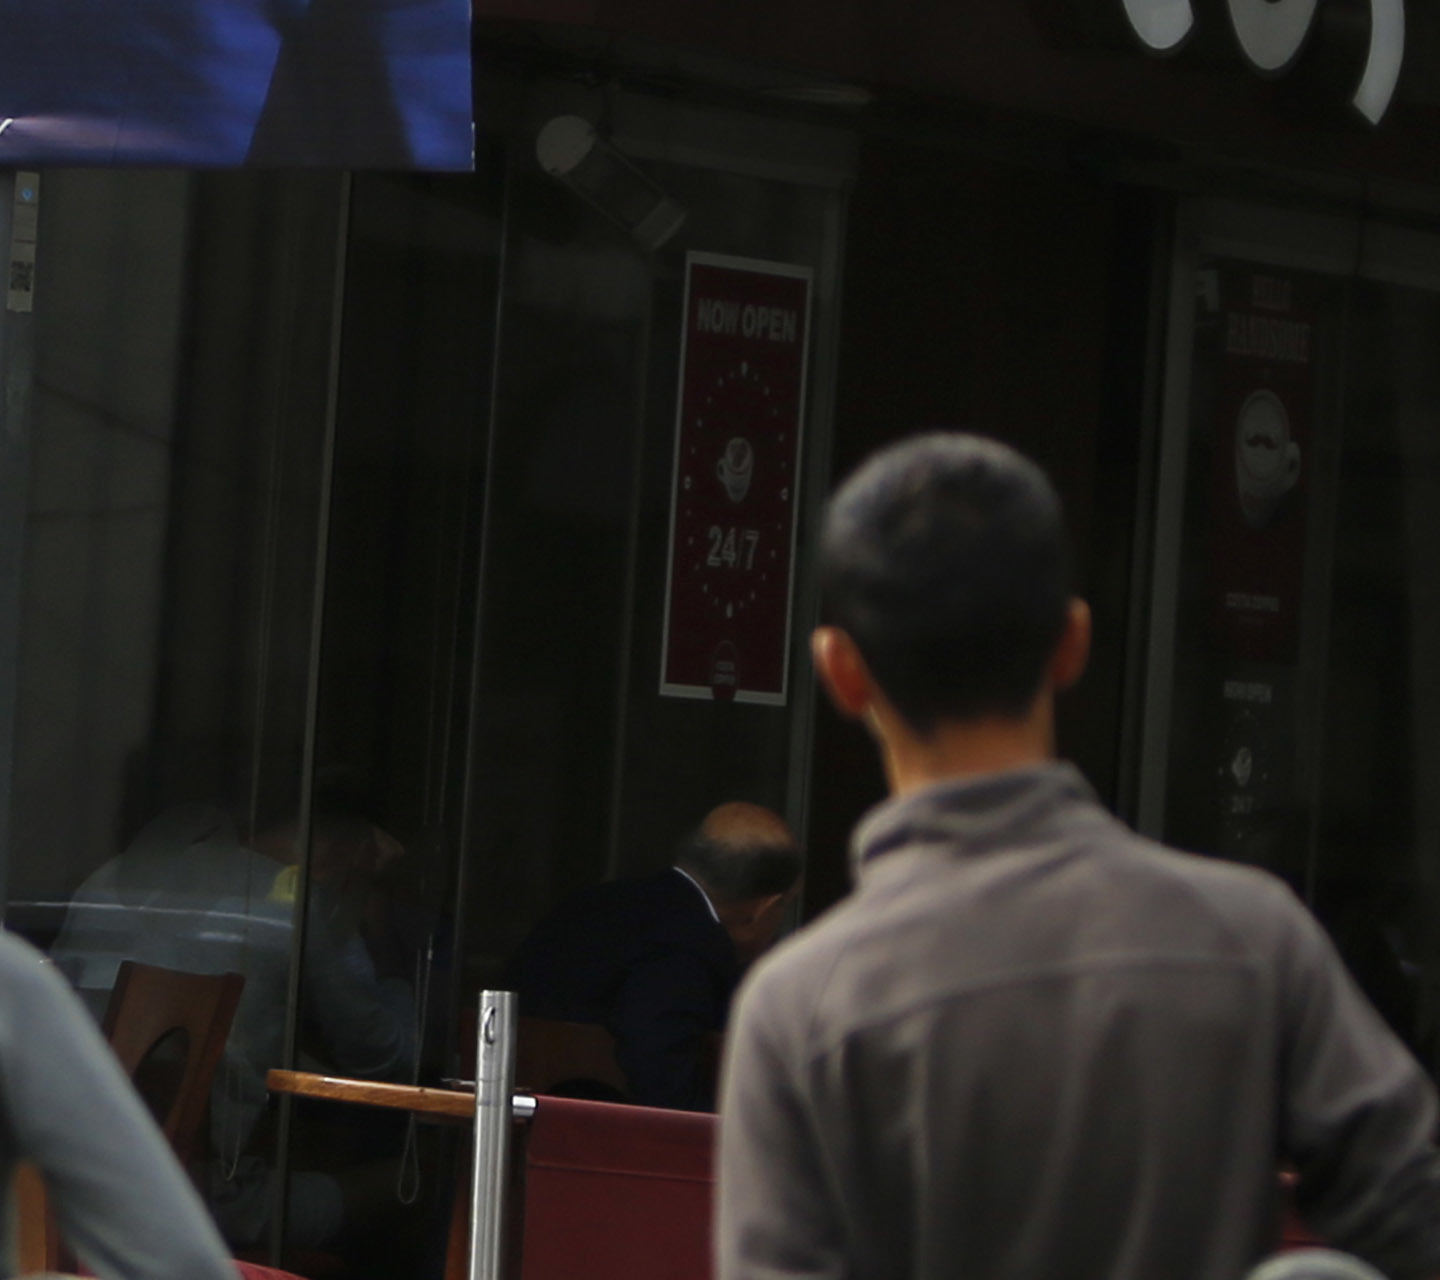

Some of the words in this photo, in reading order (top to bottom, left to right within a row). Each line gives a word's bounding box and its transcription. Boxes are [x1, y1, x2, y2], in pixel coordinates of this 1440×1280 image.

[696, 298, 740, 336] NOW
[742, 303, 797, 342] OPEN
[706, 526, 759, 570] 24/7
